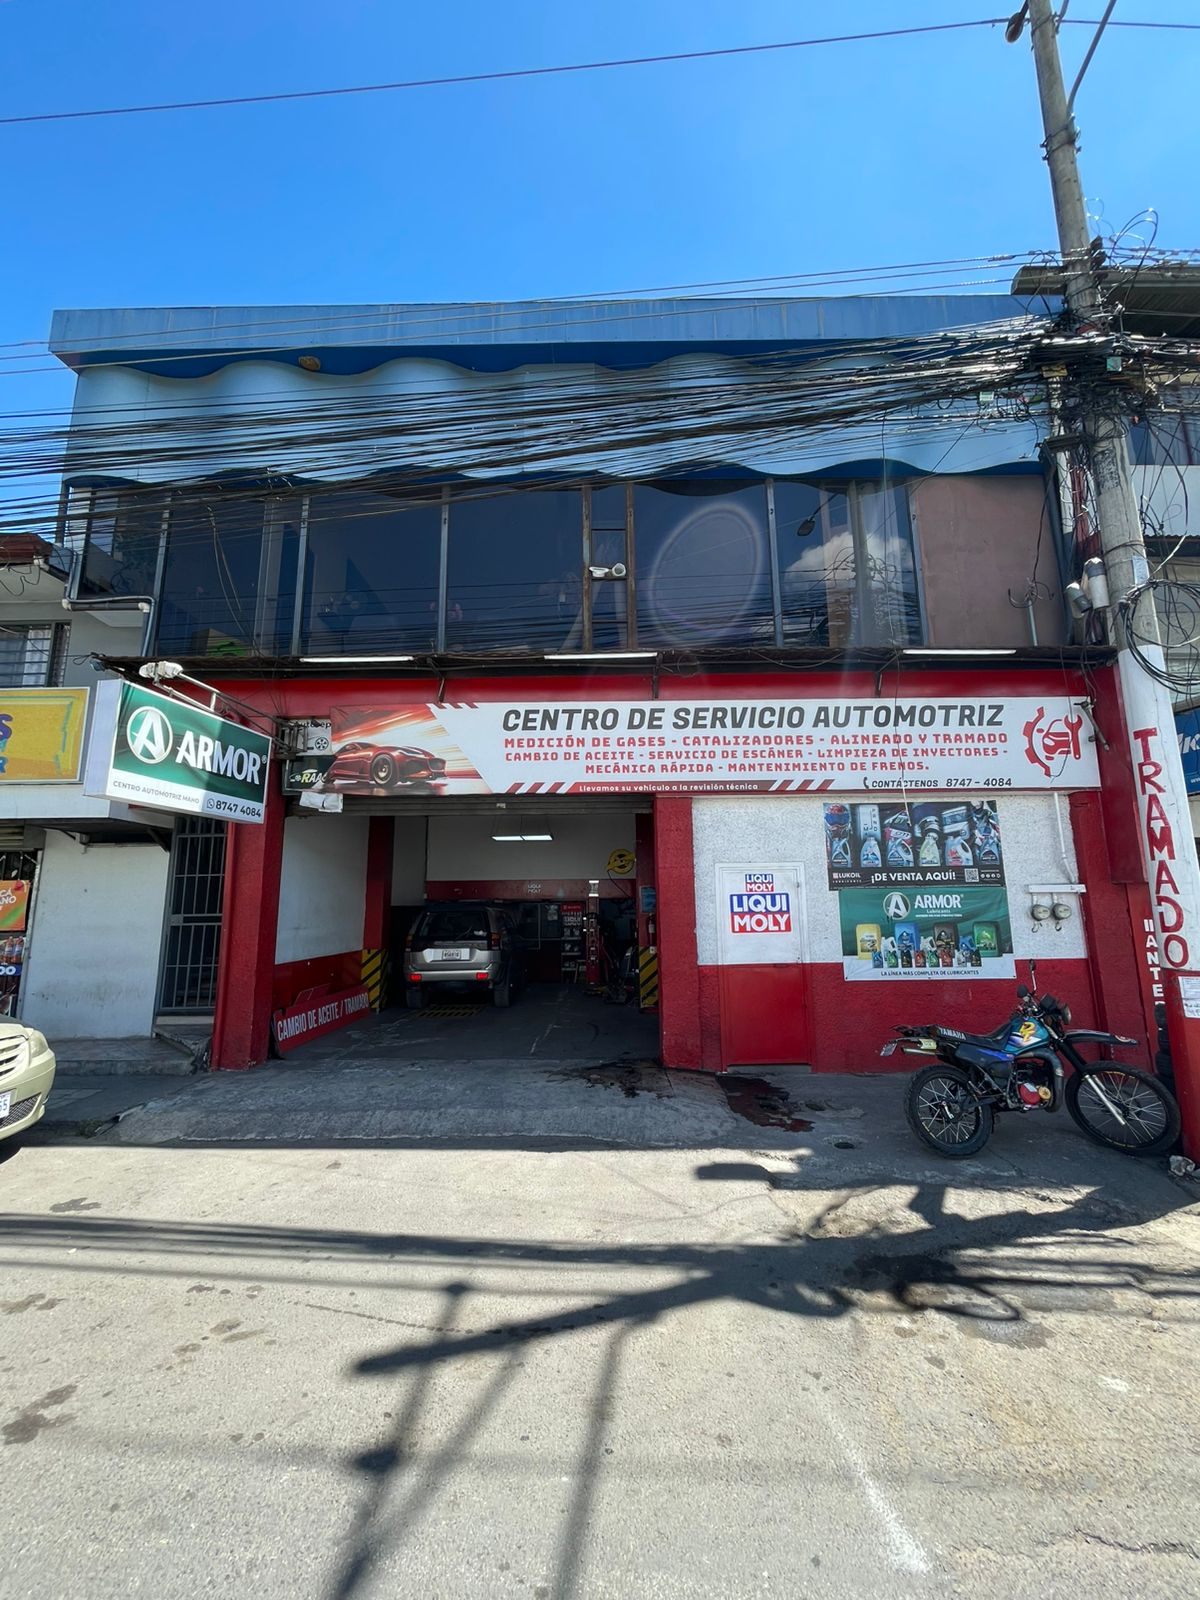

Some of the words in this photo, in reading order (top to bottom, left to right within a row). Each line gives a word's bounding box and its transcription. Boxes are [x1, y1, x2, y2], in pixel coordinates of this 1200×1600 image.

[502, 708, 620, 731] CENTRO
[627, 707, 665, 730] DE
[672, 706, 805, 729] SERVICIO
[812, 704, 1004, 728] AUTOMOTRIZ
[504, 735, 585, 748] MEDICIÓN
[591, 737, 611, 747] DE
[616, 736, 666, 747] GASES
[682, 735, 814, 746] CATALIZADORES
[830, 733, 913, 745] ALINEADO
[932, 733, 1008, 744] TRAMADO
[505, 752, 558, 761] CAMBIO
[563, 752, 580, 760] DE
[585, 751, 634, 760] ACEITE
[648, 750, 716, 760] SERVICIO
[721, 750, 738, 759] DE
[742, 747, 803, 758] ESCÁNER
[817, 749, 887, 758] LIMPIEZA
[892, 748, 908, 757] DE
[585, 762, 656, 774] MECÁNICA
[660, 761, 714, 773] RÁPIDA
[728, 762, 845, 772] MANTENIMIENTO
[850, 761, 867, 771] DE
[872, 761, 930, 770] FRENOS.
[579, 784, 619, 792] Llevamos
[689, 783, 724, 791] revisión
[726, 782, 759, 790] técnica
[871, 777, 939, 788] CONTÁCTENOS
[946, 778, 972, 787] 8747
[983, 777, 1012, 787] 4084
[113, 780, 141, 792] CENTRO
[141, 786, 182, 801] AUTOMOTRIZ
[215, 800, 239, 813] 8747
[240, 805, 262, 818] 4084
[1133, 727, 1189, 969] TRAMADO
[745, 874, 773, 883] LIQUI
[871, 872, 887, 884] ¡DE
[889, 872, 923, 881] VENTA
[925, 869, 956, 881] AQUÍ!
[746, 883, 773, 892] MOLY
[732, 894, 788, 912] LIQUI
[733, 913, 790, 932] MOLY
[277, 1013, 307, 1041] CAMBIO
[308, 1009, 317, 1030] DE
[318, 1001, 339, 1026] ACEITE
[344, 992, 369, 1015] TRAMADO
[939, 1028, 967, 1041] YAMAHA
